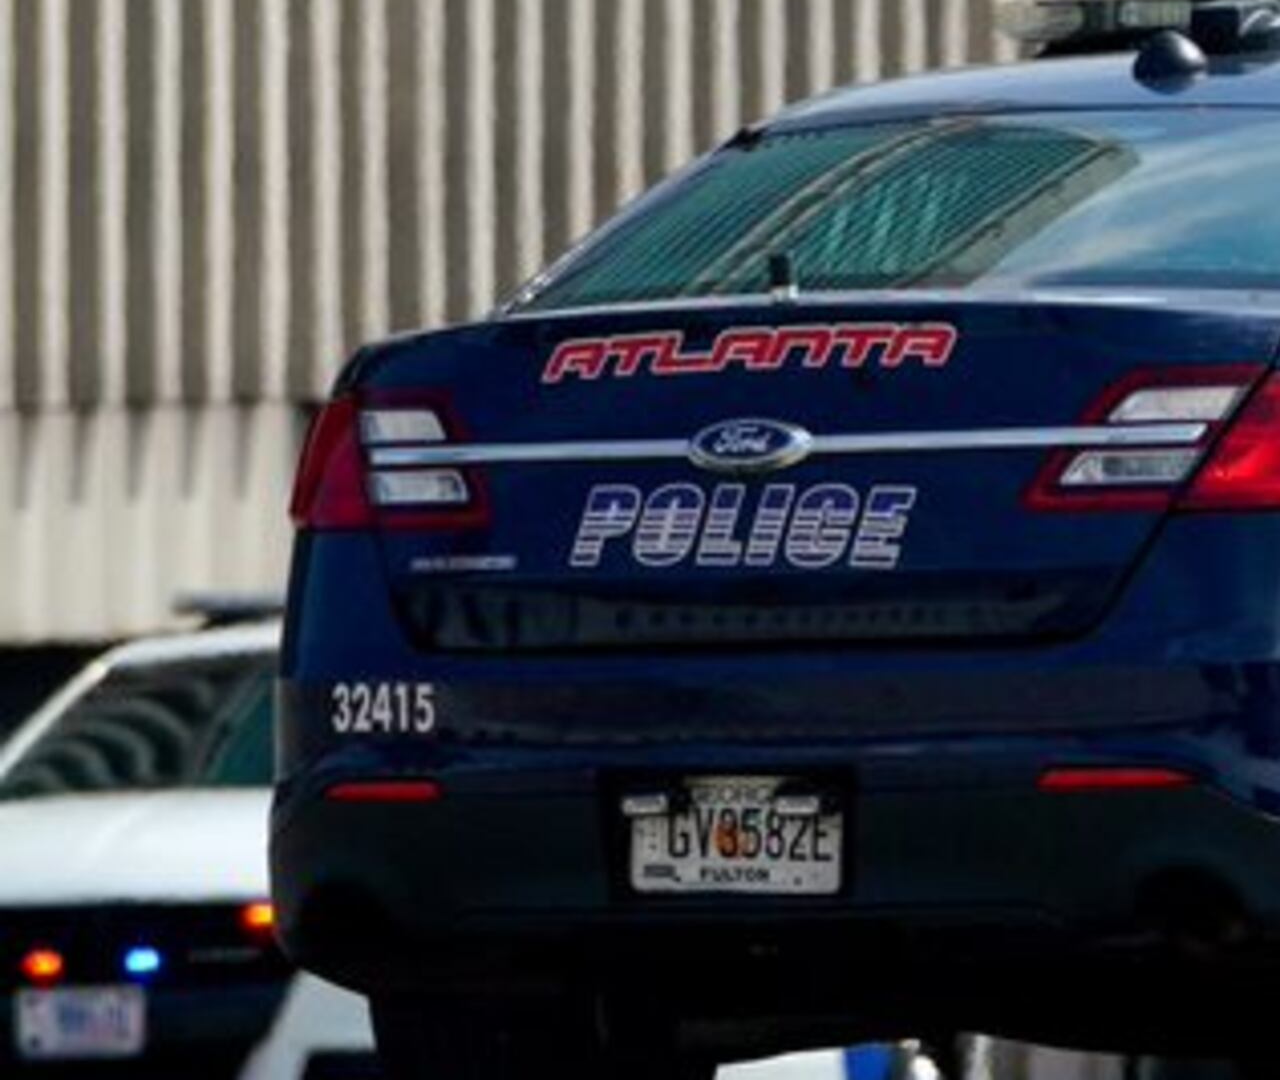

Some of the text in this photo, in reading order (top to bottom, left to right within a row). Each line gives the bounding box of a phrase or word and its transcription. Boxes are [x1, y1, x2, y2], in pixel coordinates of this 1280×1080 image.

[541, 323, 957, 384] ATLANTA
[713, 425, 771, 454] Ford
[569, 482, 917, 569] POLICE
[332, 683, 435, 733] 32415
[699, 866, 770, 882] FULTON
